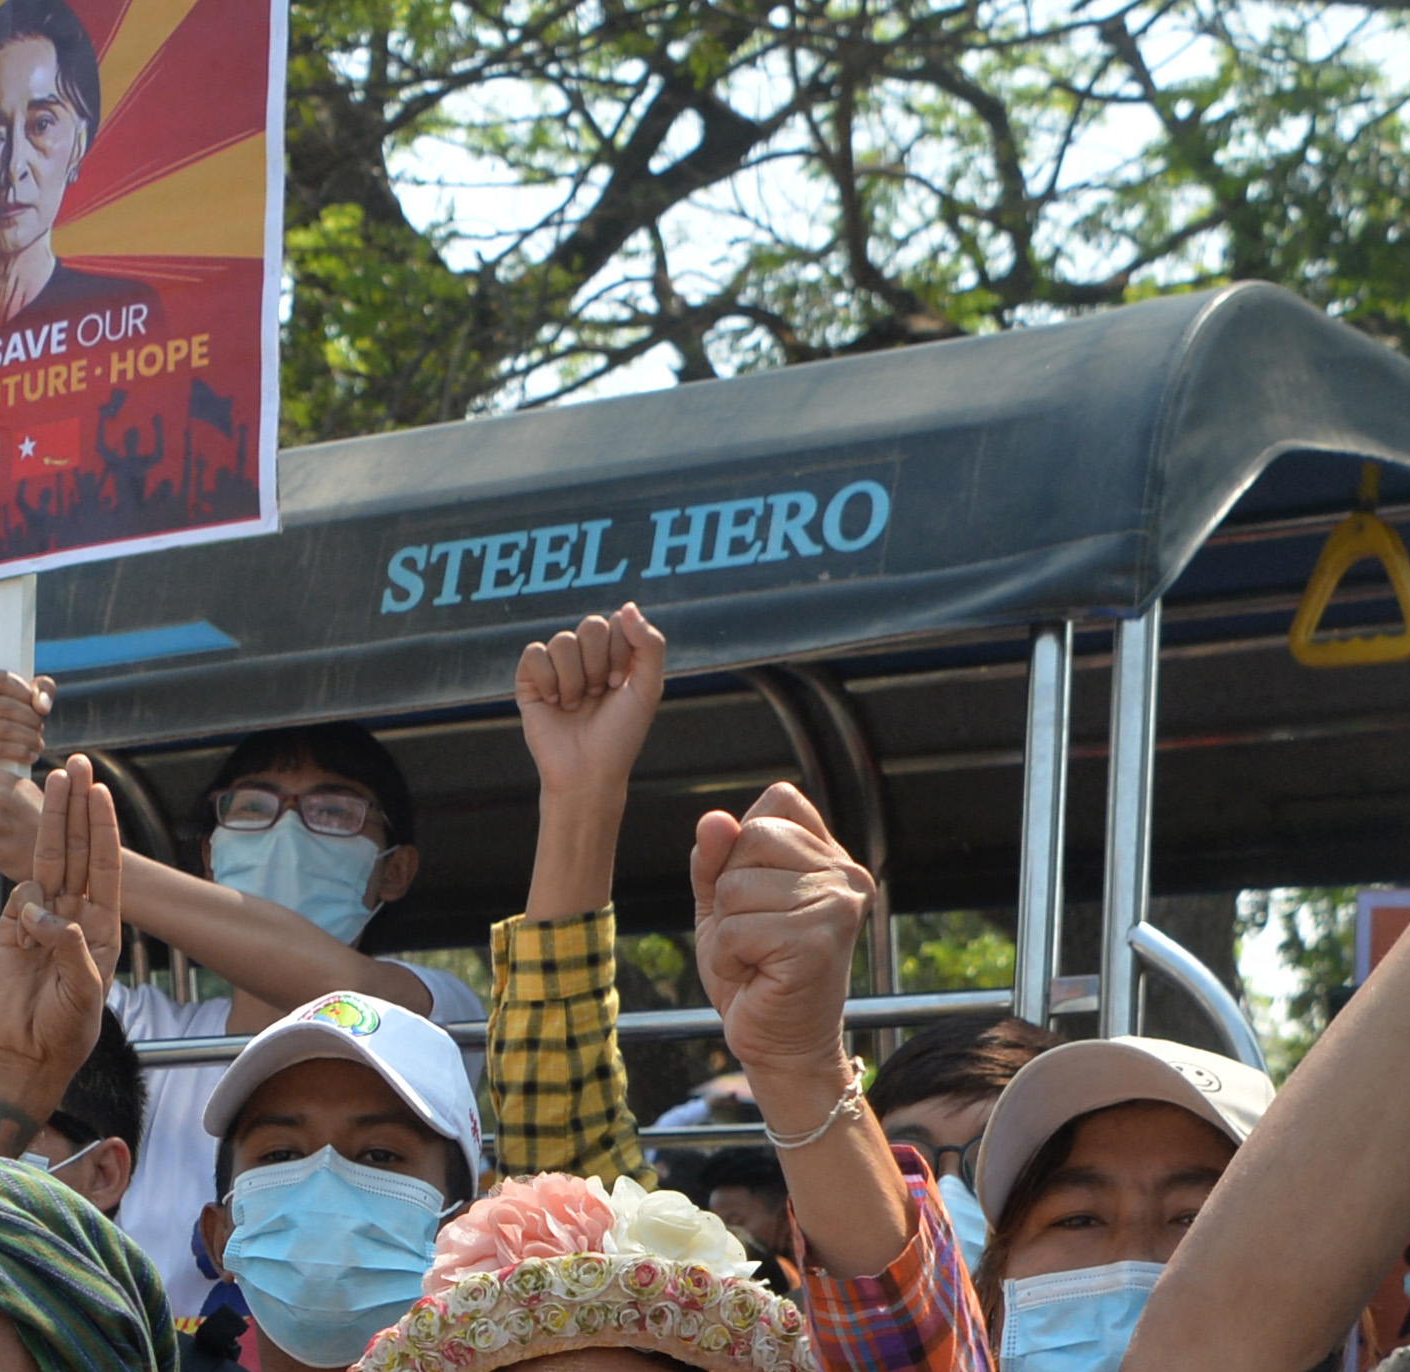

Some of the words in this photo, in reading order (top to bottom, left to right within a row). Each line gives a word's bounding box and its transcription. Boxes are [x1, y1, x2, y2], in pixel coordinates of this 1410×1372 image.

[77, 303, 148, 349] OUR
[110, 334, 210, 384] HOPE
[380, 518, 628, 614] STEEL
[641, 480, 891, 579] HERO
